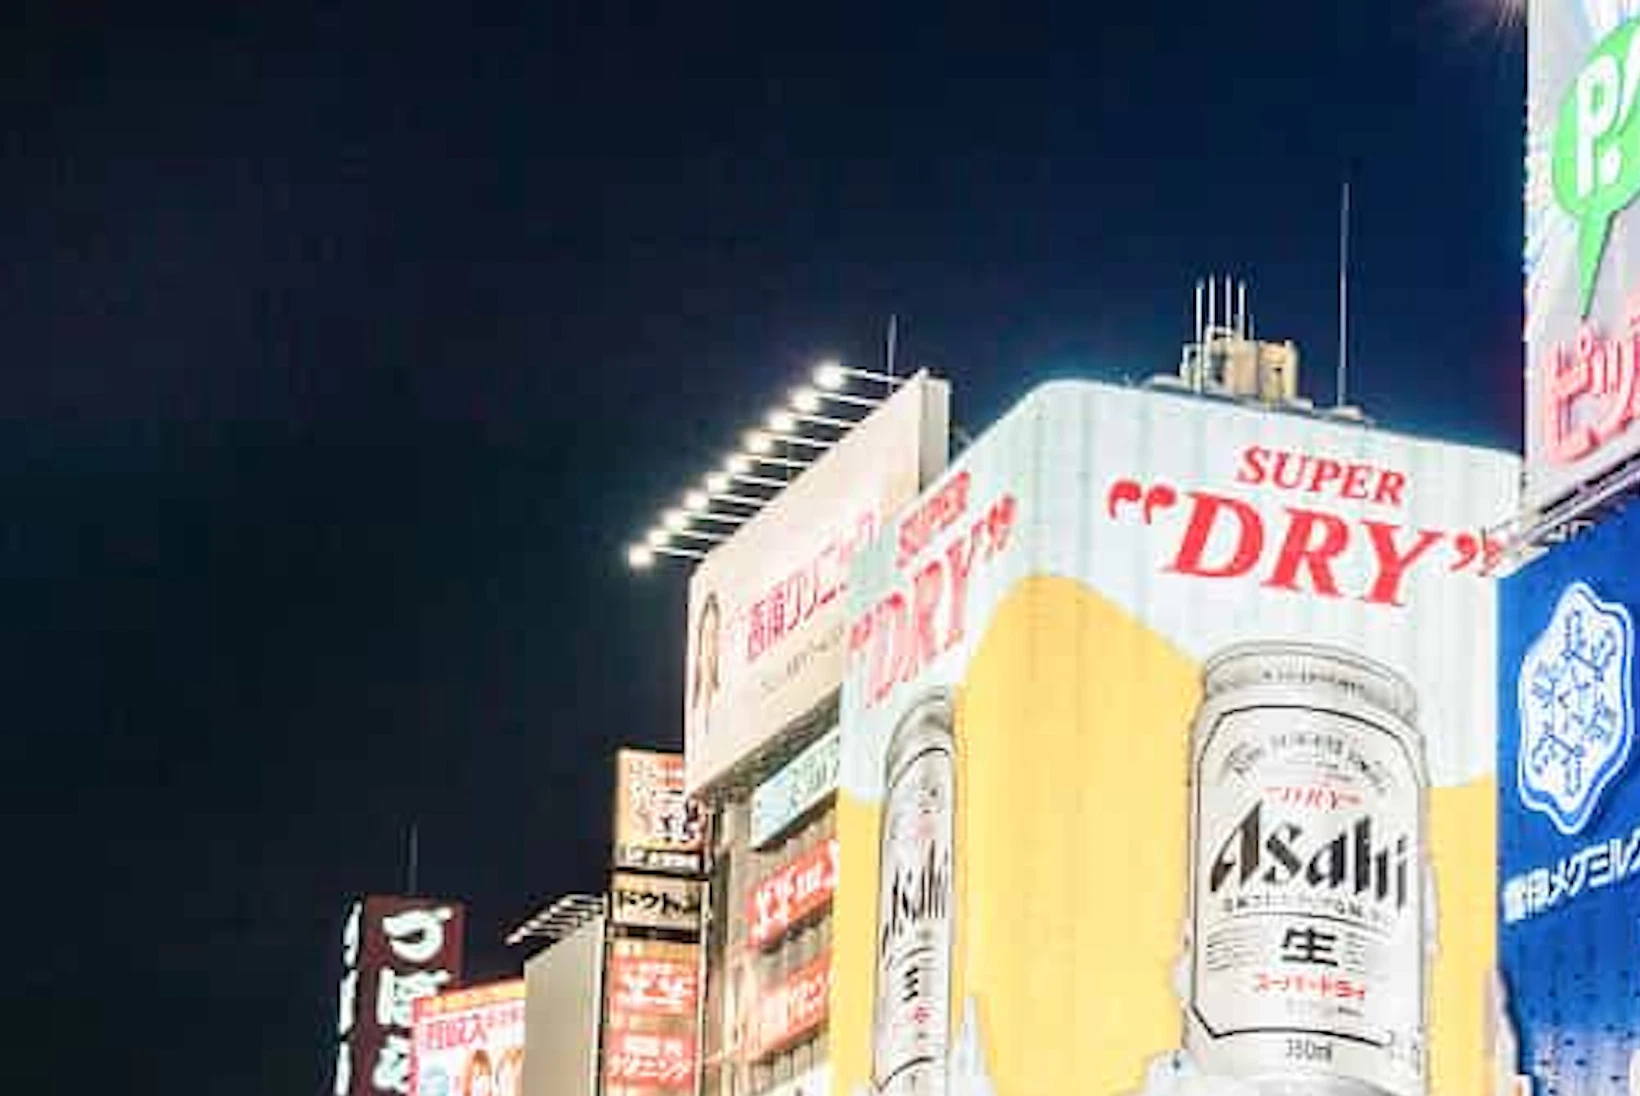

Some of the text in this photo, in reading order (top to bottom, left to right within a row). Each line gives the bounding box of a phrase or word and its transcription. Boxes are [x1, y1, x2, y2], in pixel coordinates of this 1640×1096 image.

[1236, 446, 1405, 502] SUPER
[1208, 798, 1410, 916] Asahi
[1280, 924, 1342, 967] 生
